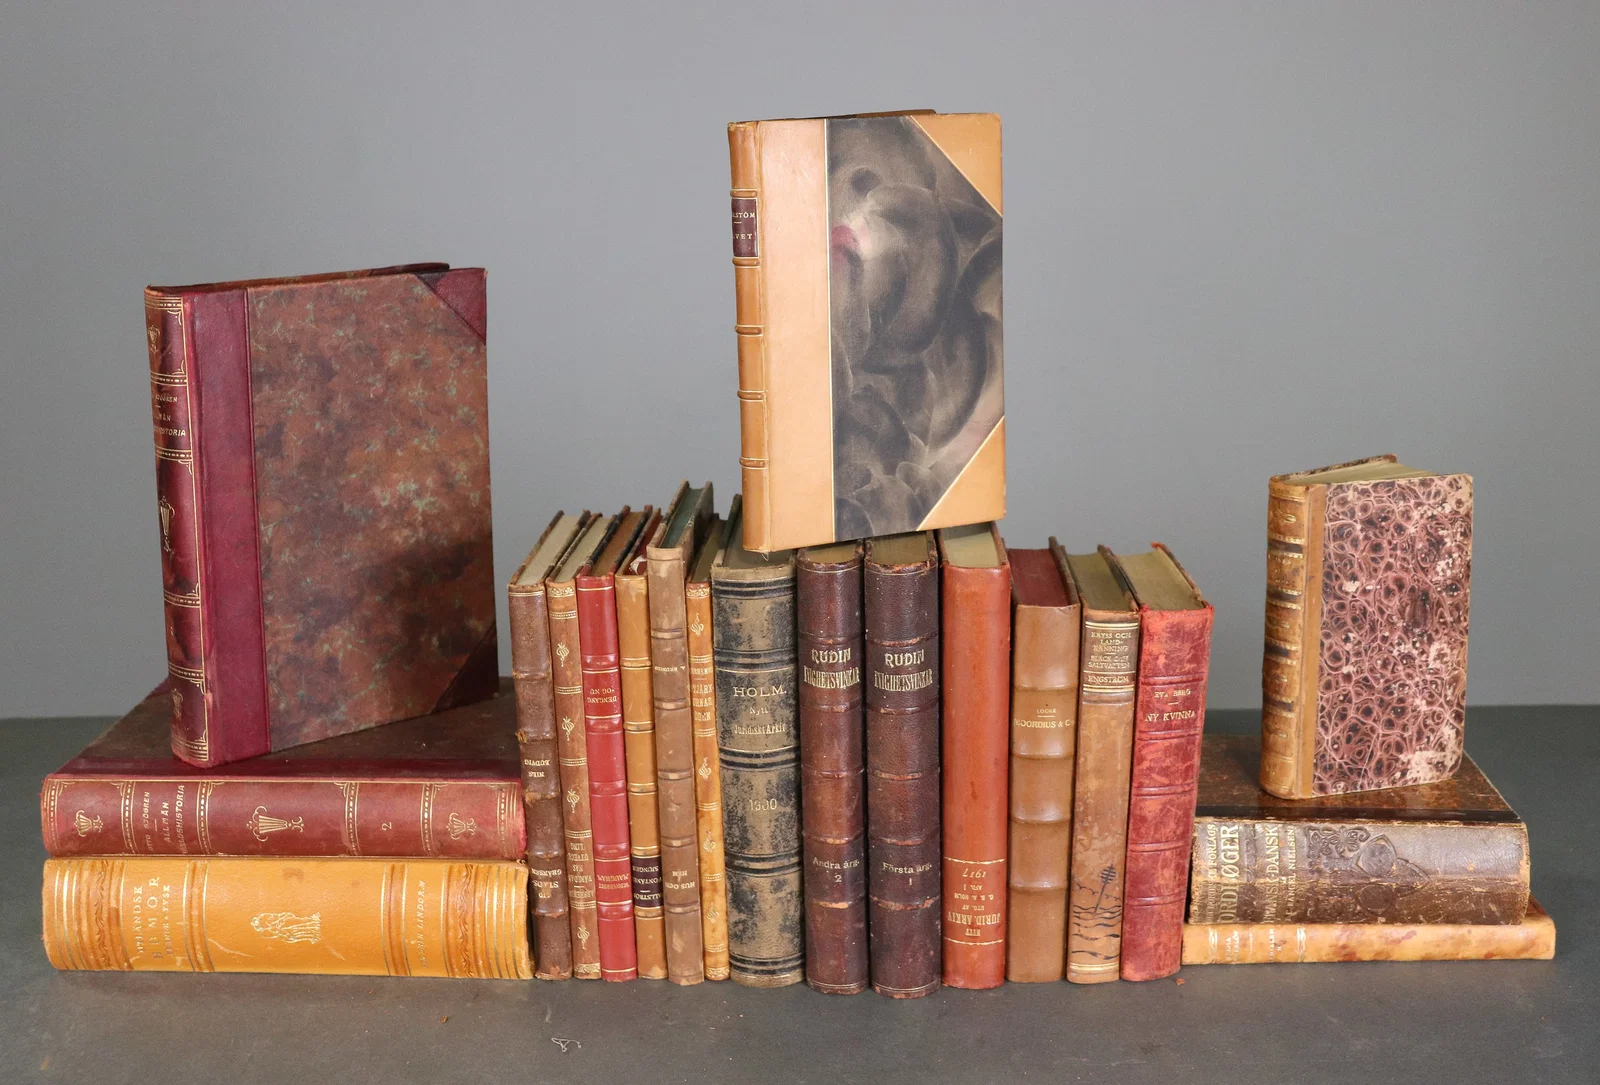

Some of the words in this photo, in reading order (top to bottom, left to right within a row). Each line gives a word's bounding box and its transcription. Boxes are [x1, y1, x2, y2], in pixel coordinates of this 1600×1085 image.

[811, 647, 851, 664] RUDIN
[884, 649, 925, 668] RUDIN
[1145, 713, 1160, 722] NY
[1163, 710, 1196, 721] KVINNA
[749, 797, 778, 811] 1900
[382, 821, 392, 832] 2
[813, 856, 841, 870] Andra
[882, 861, 914, 875] Första
[834, 875, 843, 883] 2
[962, 868, 987, 878] 1917
[416, 881, 426, 929] LINDORM
[947, 911, 973, 926] ARKIV
